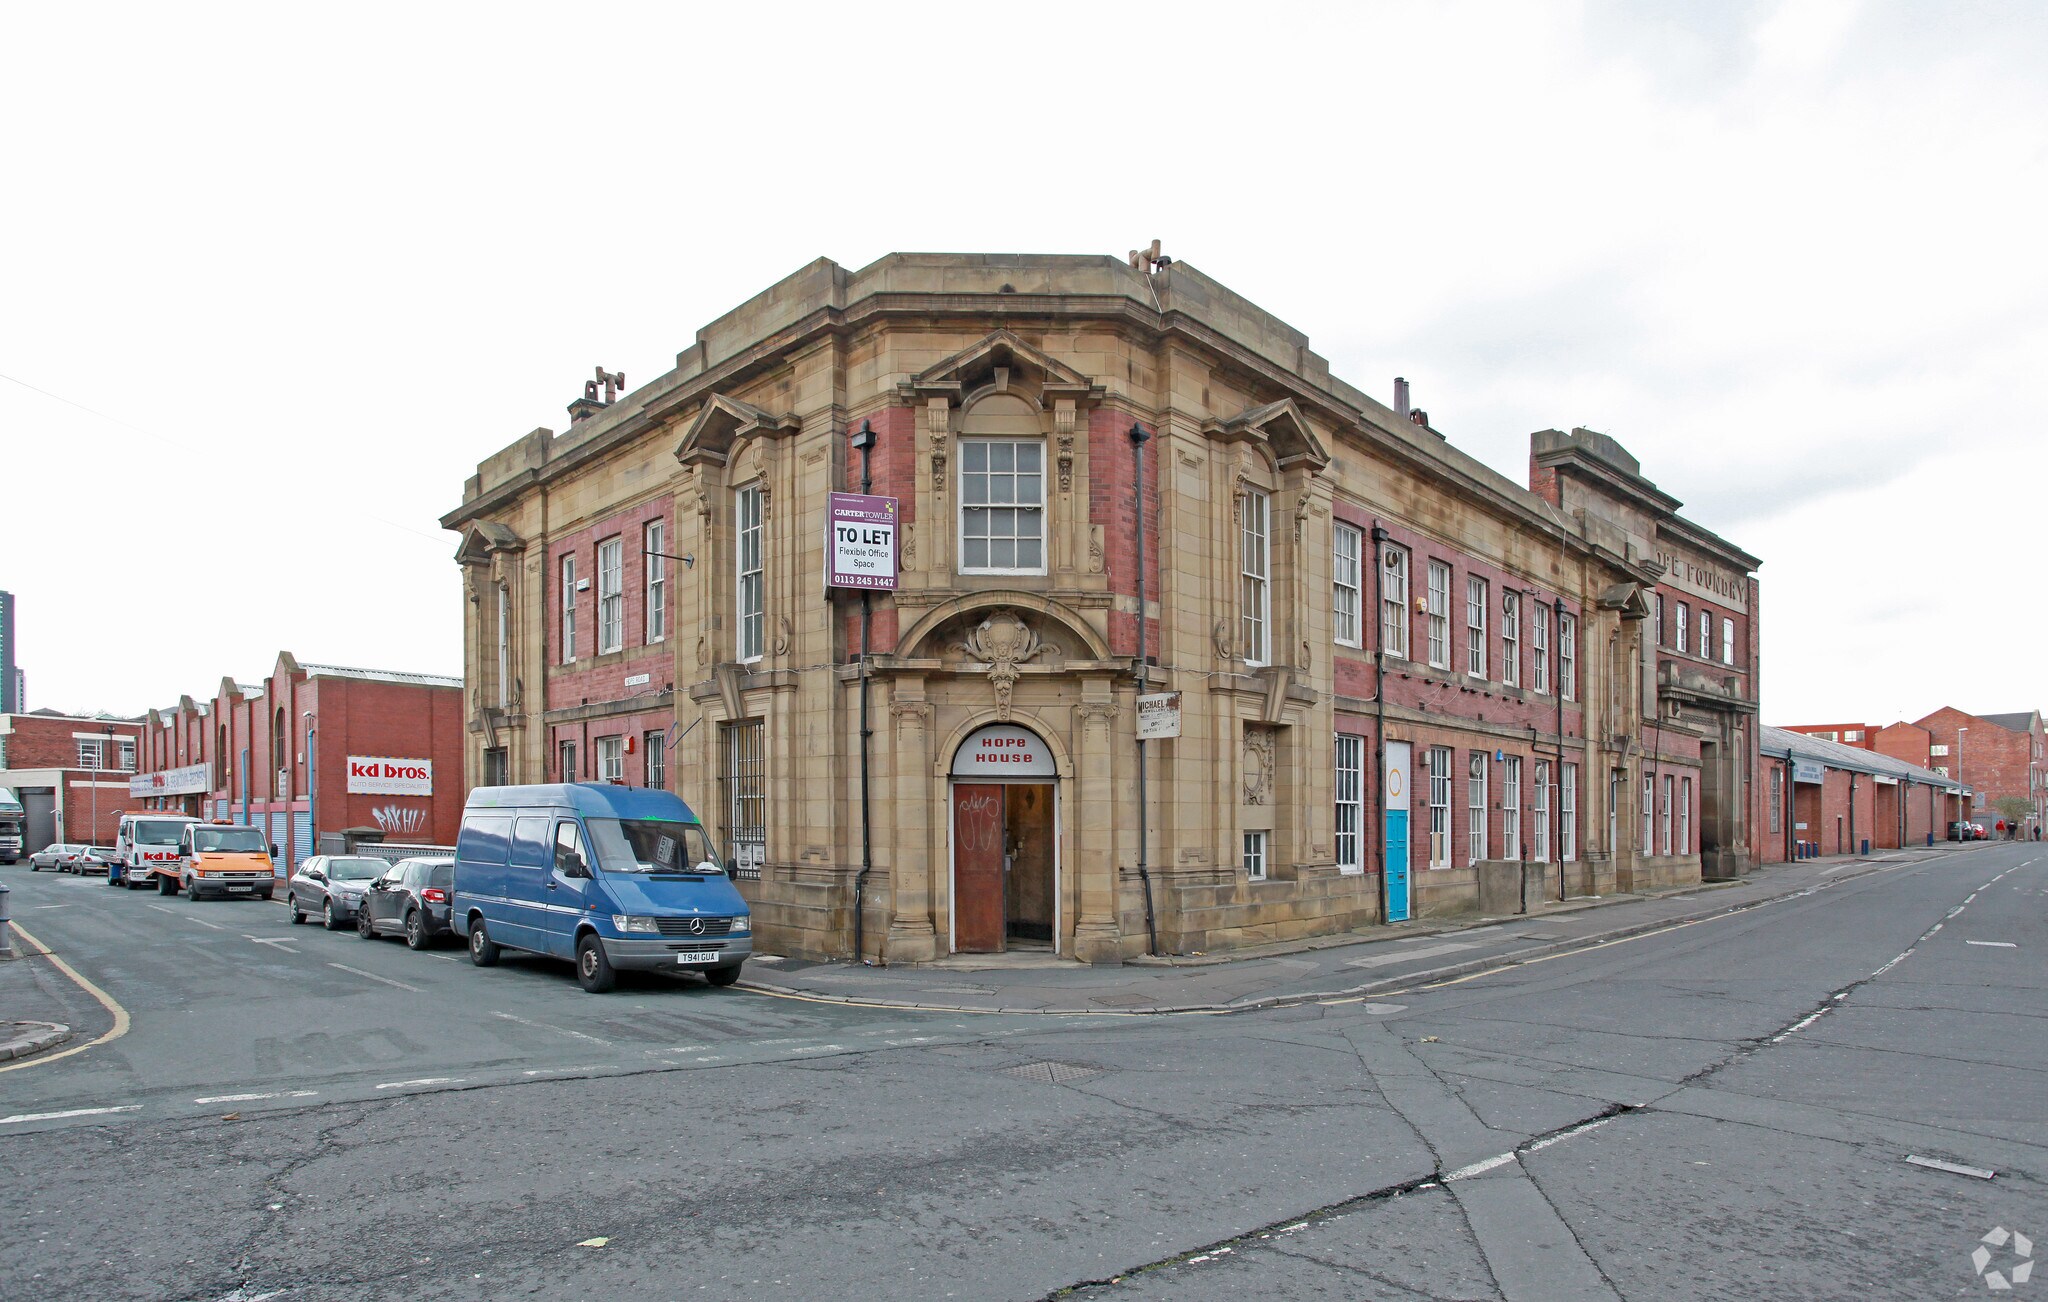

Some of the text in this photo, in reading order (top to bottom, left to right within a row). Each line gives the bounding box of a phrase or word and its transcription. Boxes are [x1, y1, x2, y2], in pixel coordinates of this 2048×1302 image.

[837, 526, 891, 545] TO LET
[839, 546, 889, 559] Flexible Office
[853, 559, 875, 569] Space
[834, 574, 894, 587] 0113 245 1447
[1137, 699, 1165, 713] MICHAEL
[351, 762, 430, 780] kd bros.
[143, 851, 164, 861] kd
[682, 952, 715, 962] T941 GUA
